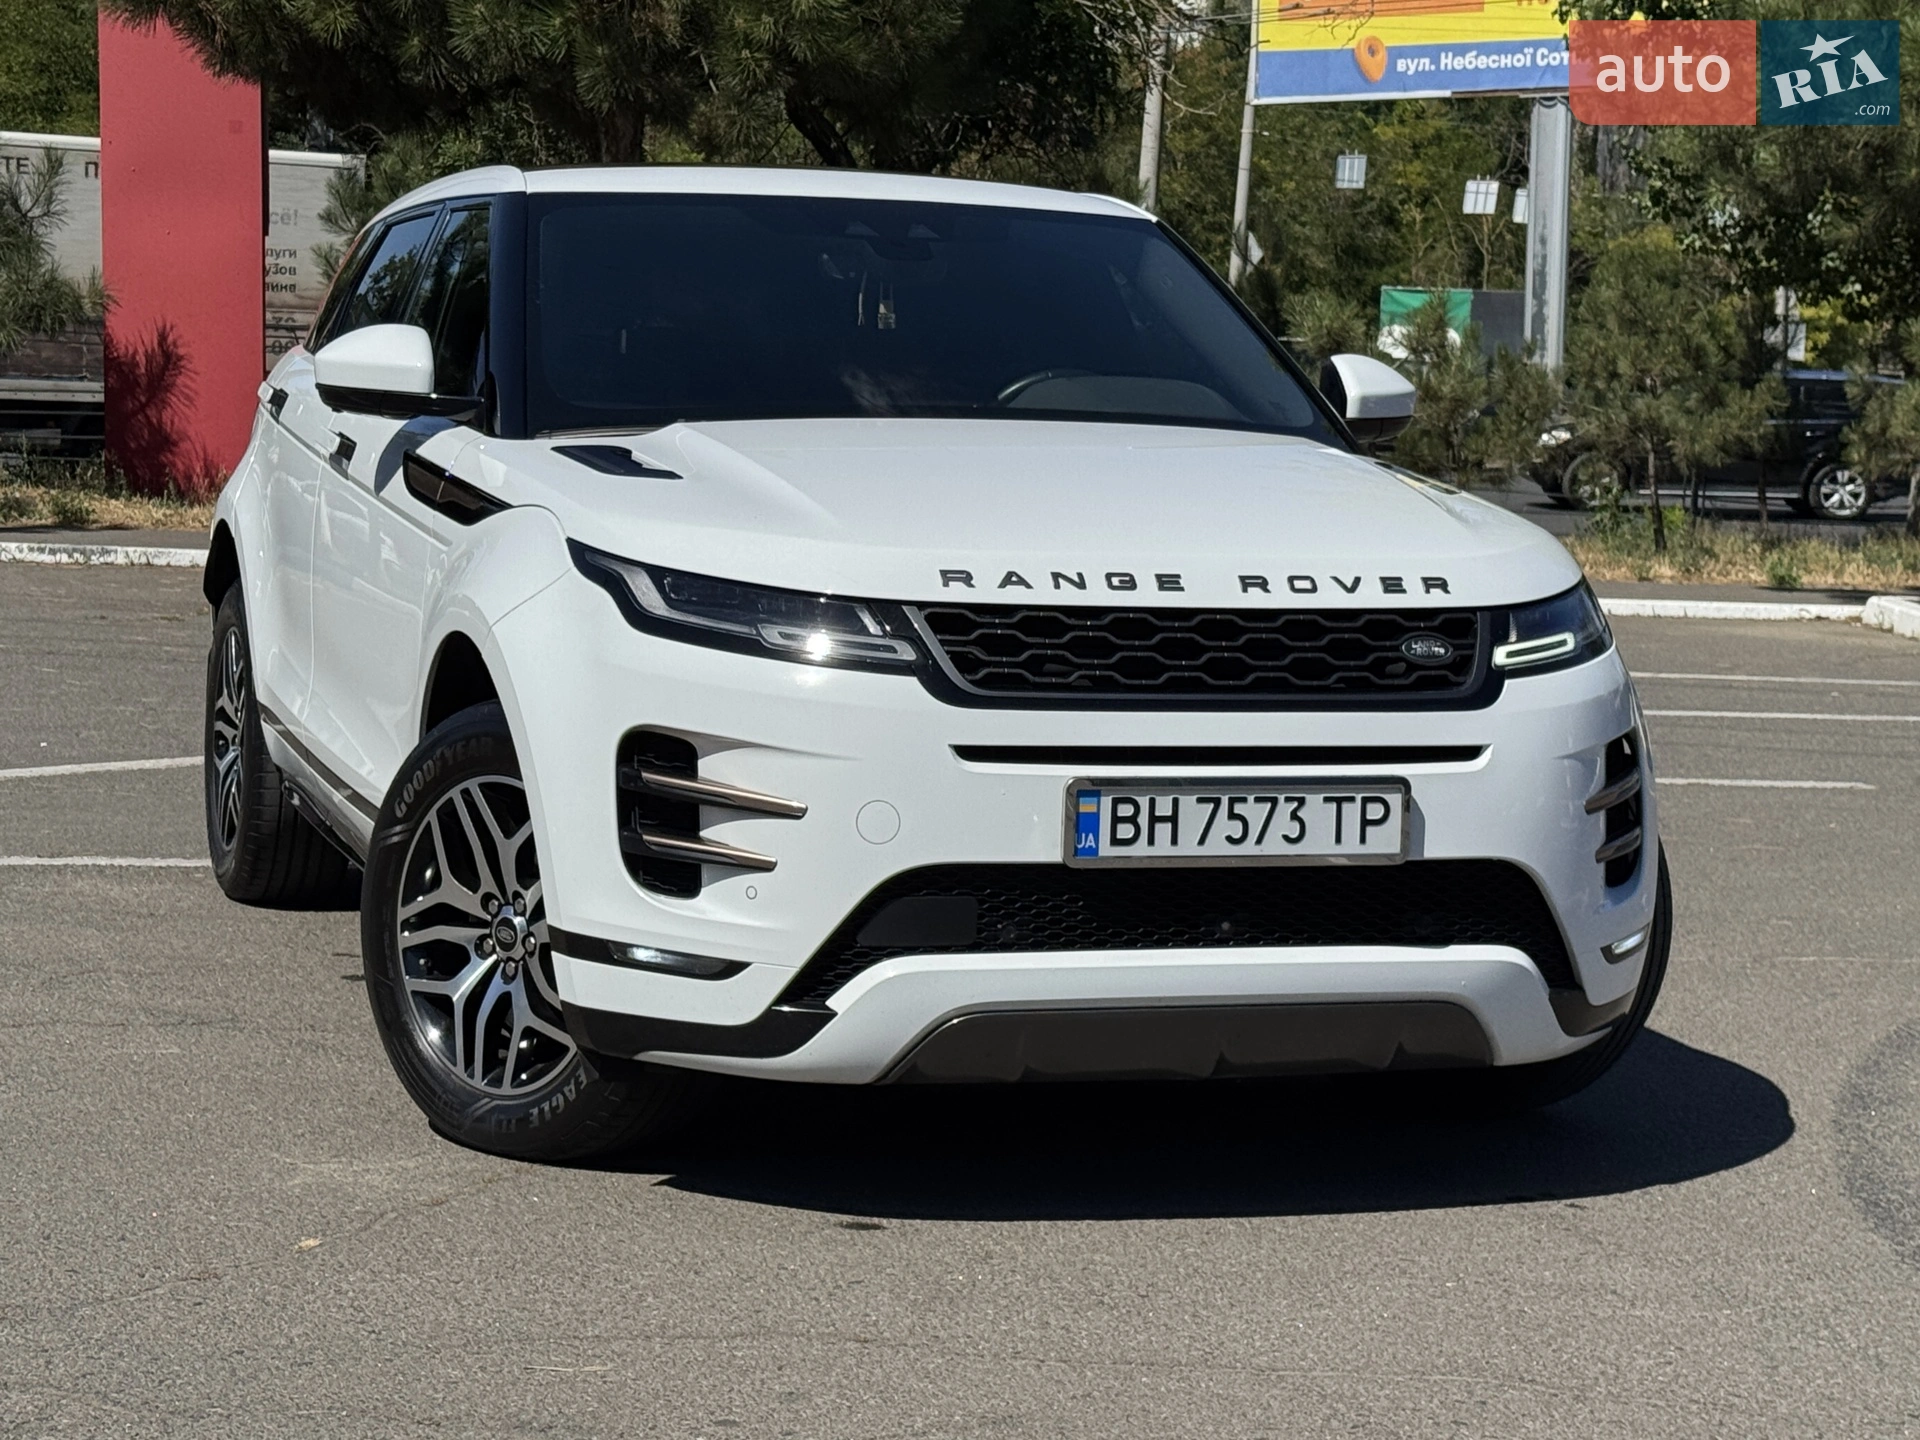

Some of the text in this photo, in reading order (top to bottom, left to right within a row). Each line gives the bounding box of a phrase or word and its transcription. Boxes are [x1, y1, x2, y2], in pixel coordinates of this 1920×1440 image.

[1396, 57, 1436, 76] вул.
[1440, 47, 1533, 72] Небесної
[938, 569, 1452, 595] RANGE ROVER
[1109, 795, 1391, 847] BH 7573 TP
[1075, 832, 1096, 849] UA
[528, 1066, 589, 1129] EAGLE
